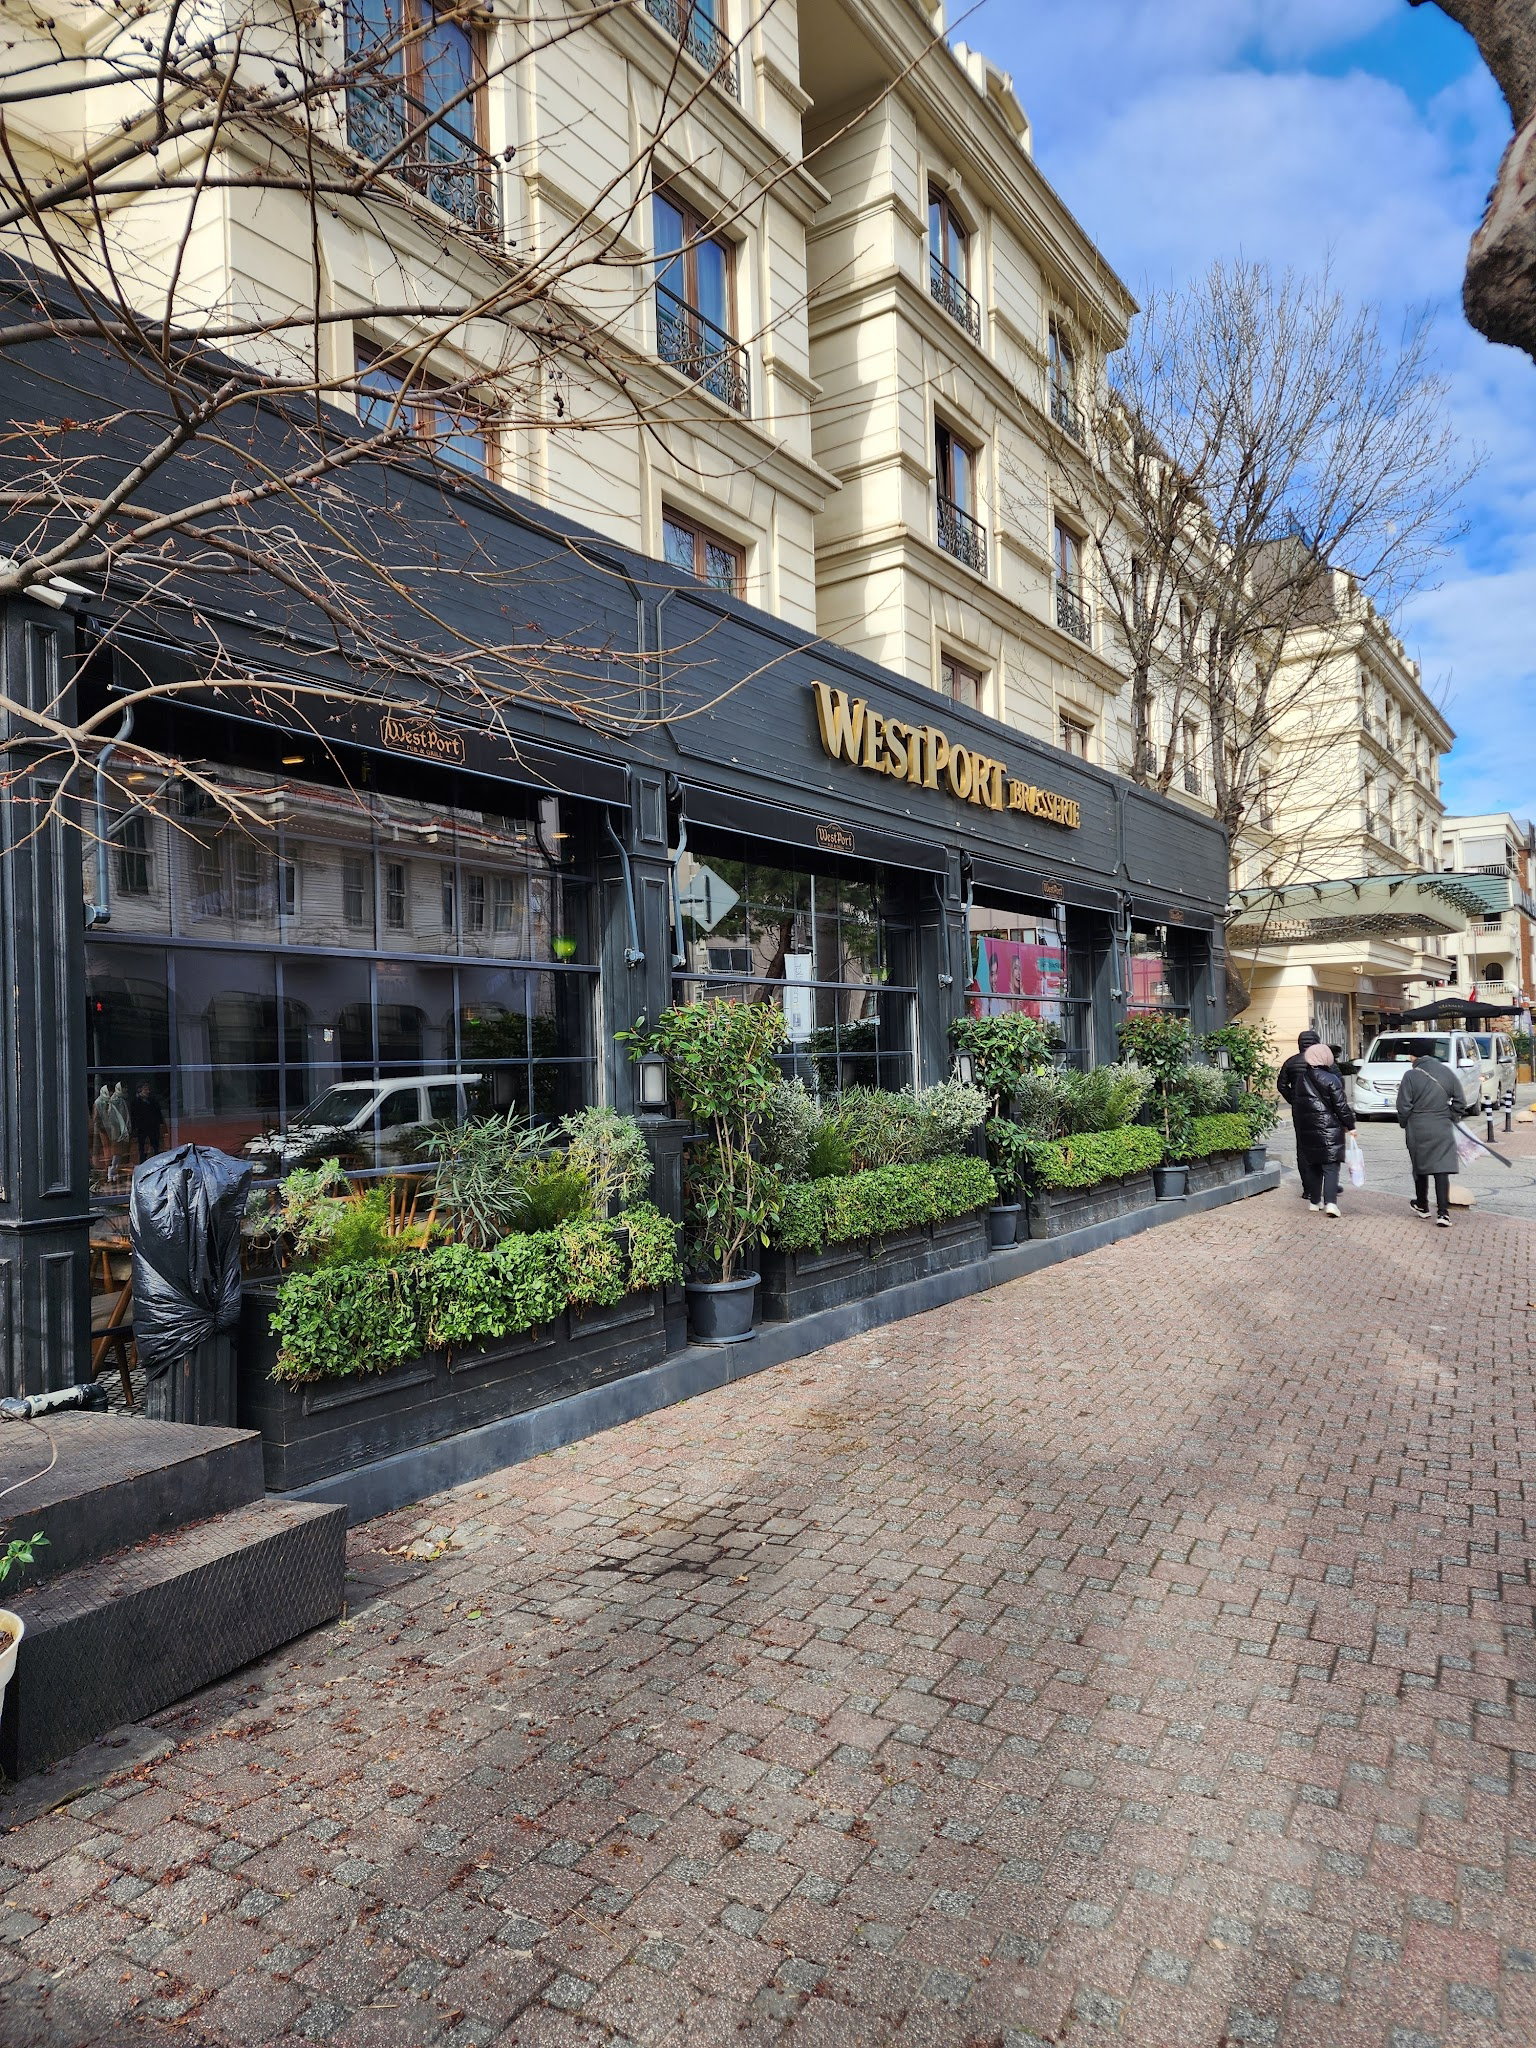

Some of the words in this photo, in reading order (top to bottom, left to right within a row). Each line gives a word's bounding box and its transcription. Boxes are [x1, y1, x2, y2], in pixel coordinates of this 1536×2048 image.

[385, 720, 460, 755] WestPort
[1006, 778, 1080, 829] BRASSERIE
[818, 827, 852, 847] WestPort
